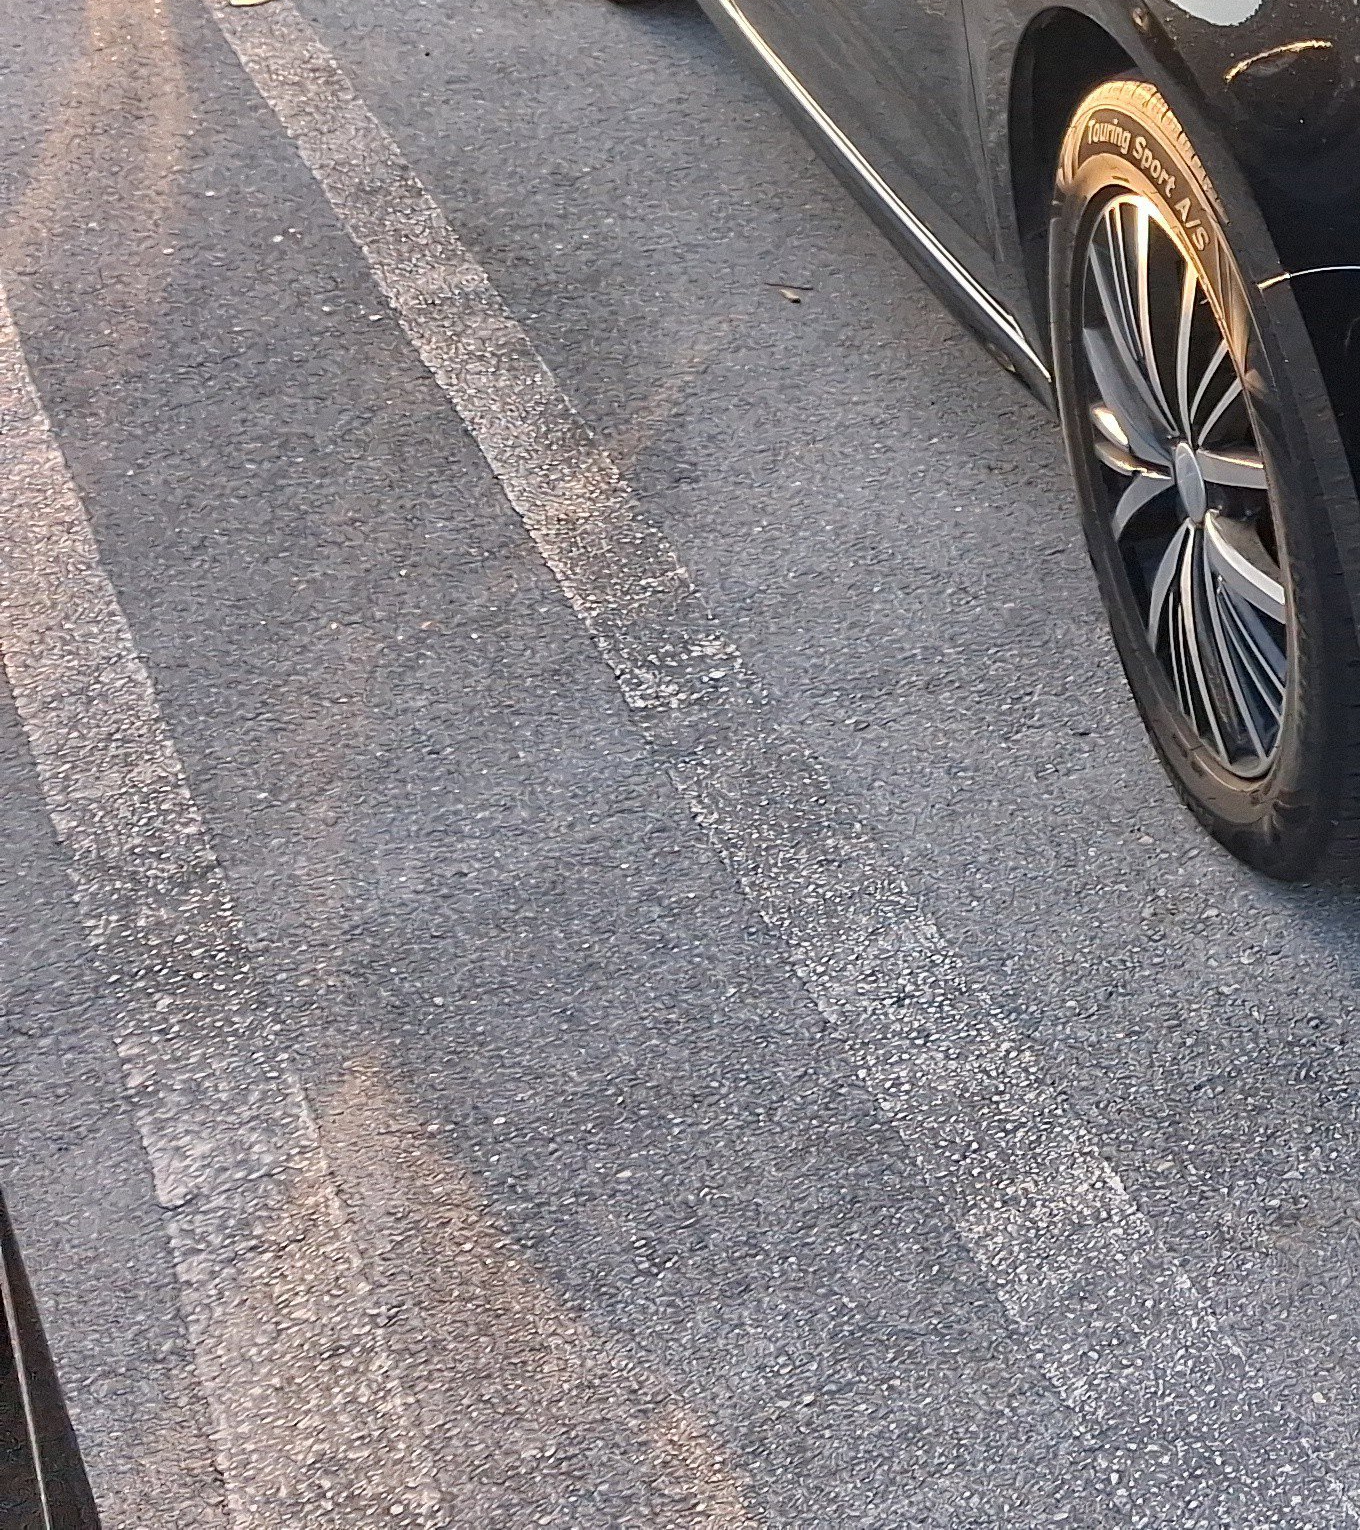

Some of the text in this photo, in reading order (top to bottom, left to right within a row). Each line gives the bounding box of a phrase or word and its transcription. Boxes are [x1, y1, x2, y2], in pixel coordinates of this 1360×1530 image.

[1087, 118, 1211, 251] Touring Sport A/S
